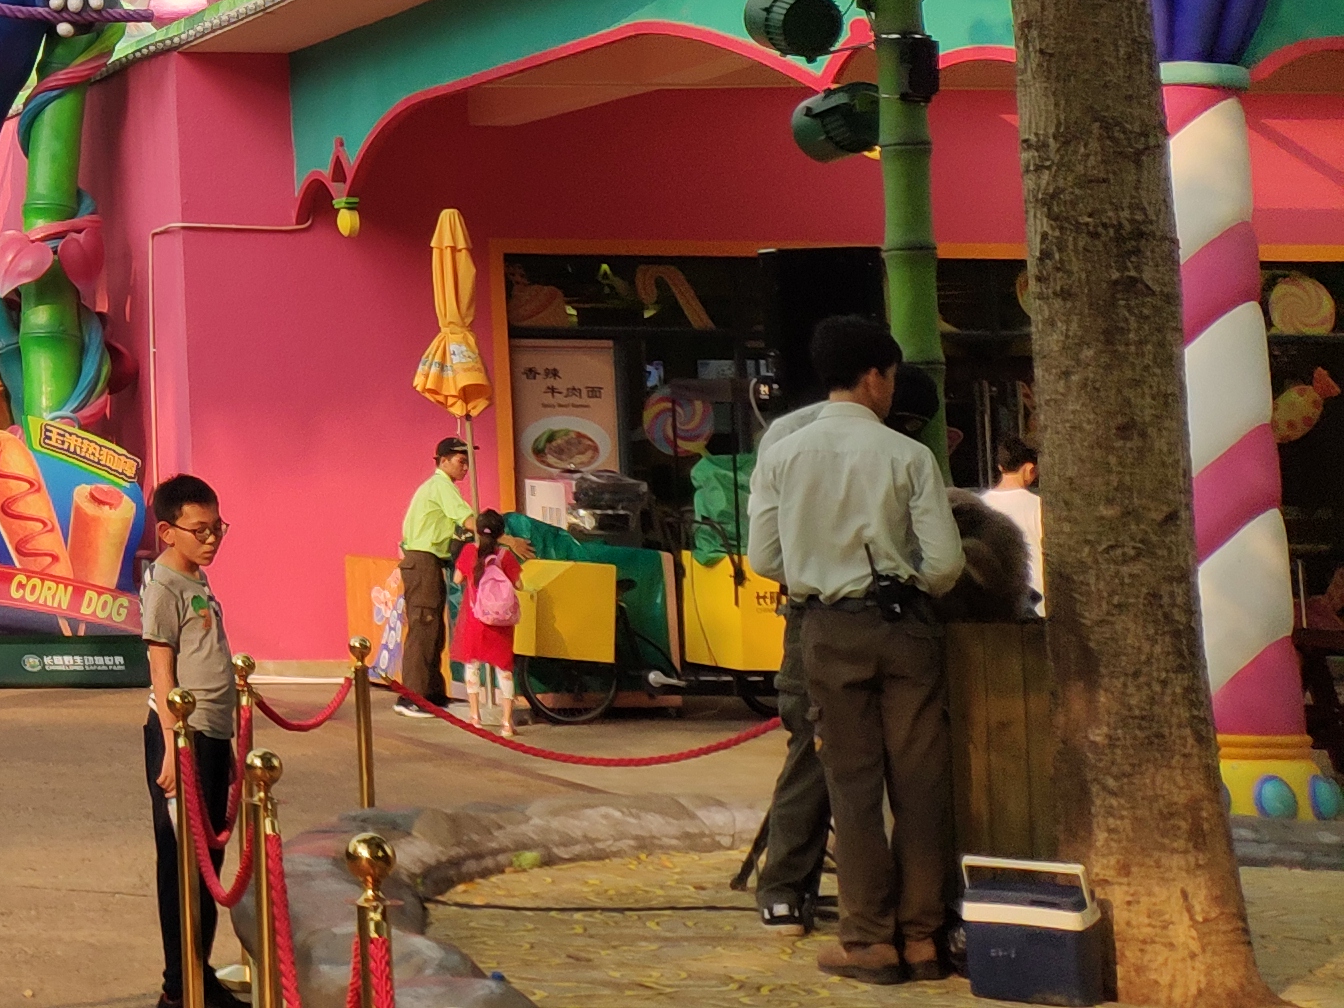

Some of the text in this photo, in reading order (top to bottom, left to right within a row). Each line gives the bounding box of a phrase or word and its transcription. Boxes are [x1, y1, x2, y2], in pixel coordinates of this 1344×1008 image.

[522, 366, 562, 380] 香辣
[543, 385, 604, 399] 牛肉面
[10, 574, 129, 622] CORN DOG
